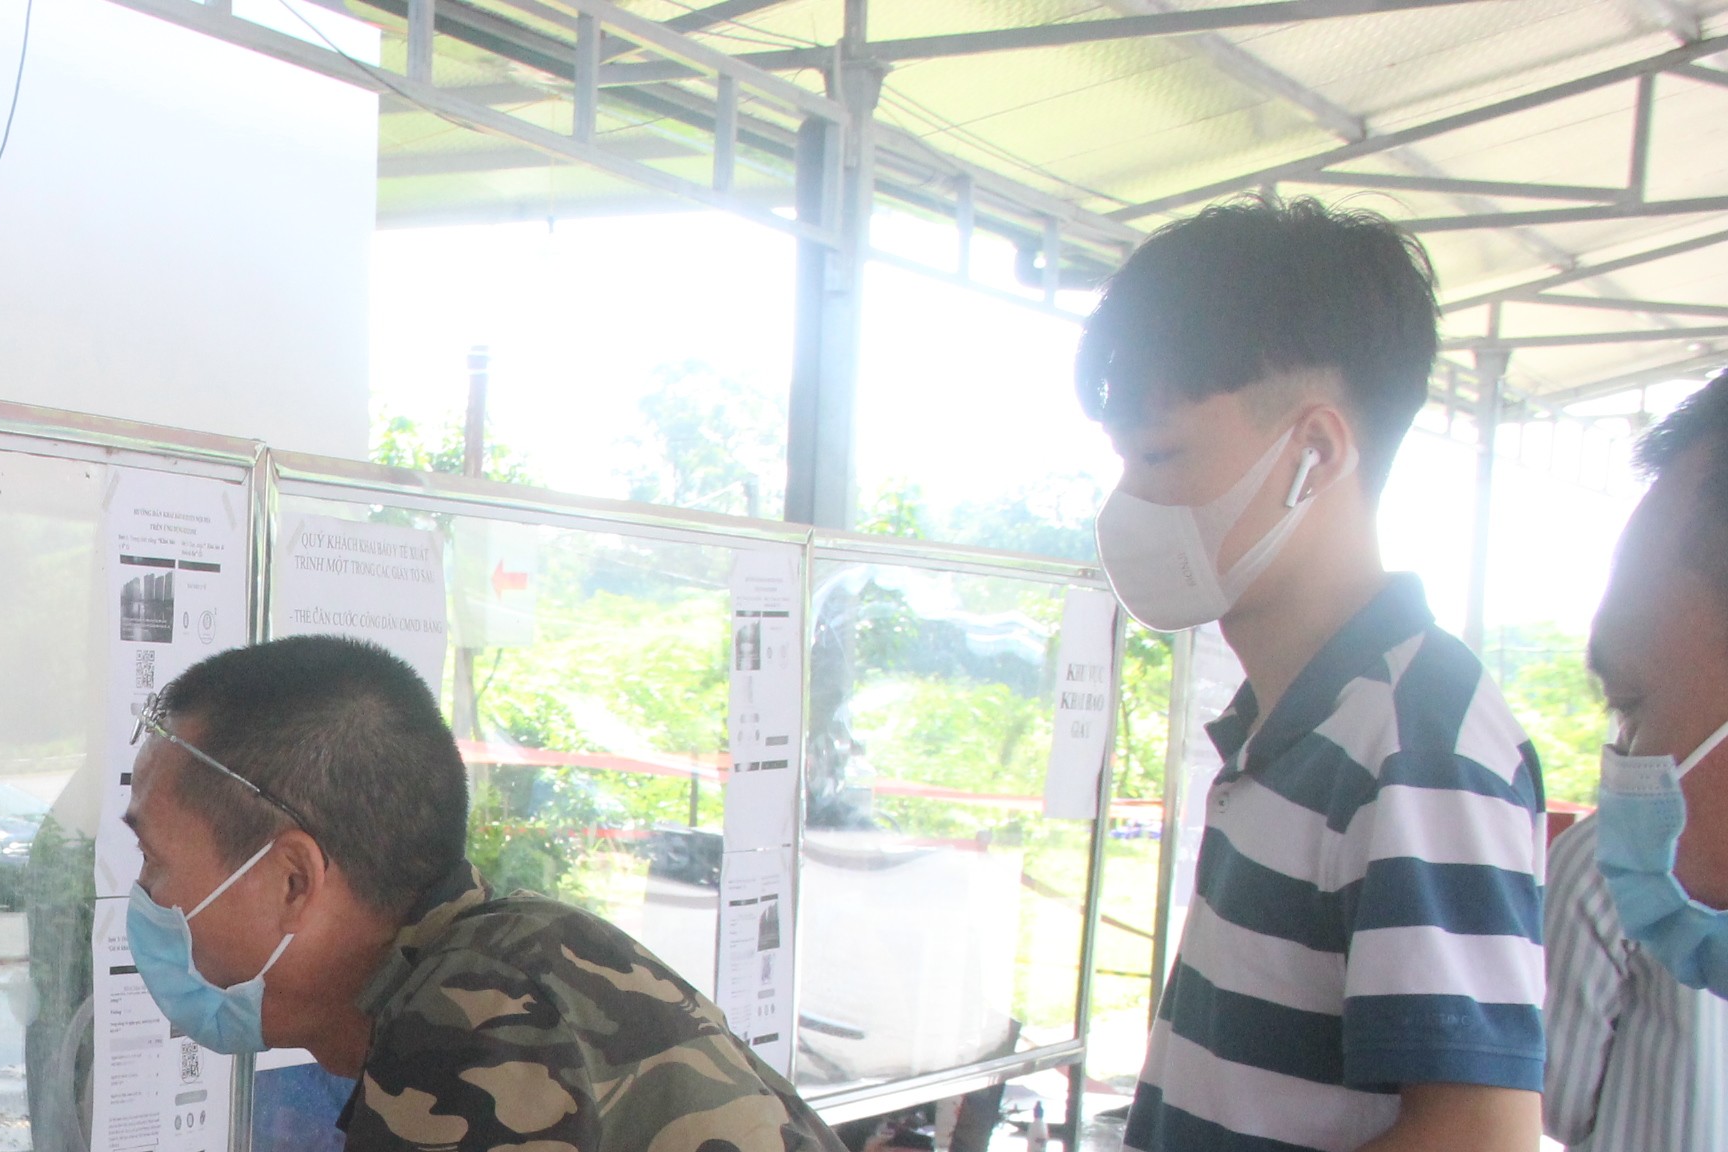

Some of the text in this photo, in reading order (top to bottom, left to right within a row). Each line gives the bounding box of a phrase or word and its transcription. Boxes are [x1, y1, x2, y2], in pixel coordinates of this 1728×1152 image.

[301, 530, 325, 550] QUÝ
[326, 533, 358, 553] KHÁCH
[358, 538, 376, 556] KHAI
[325, 556, 348, 575] MỘT
[350, 560, 375, 577] TRONG
